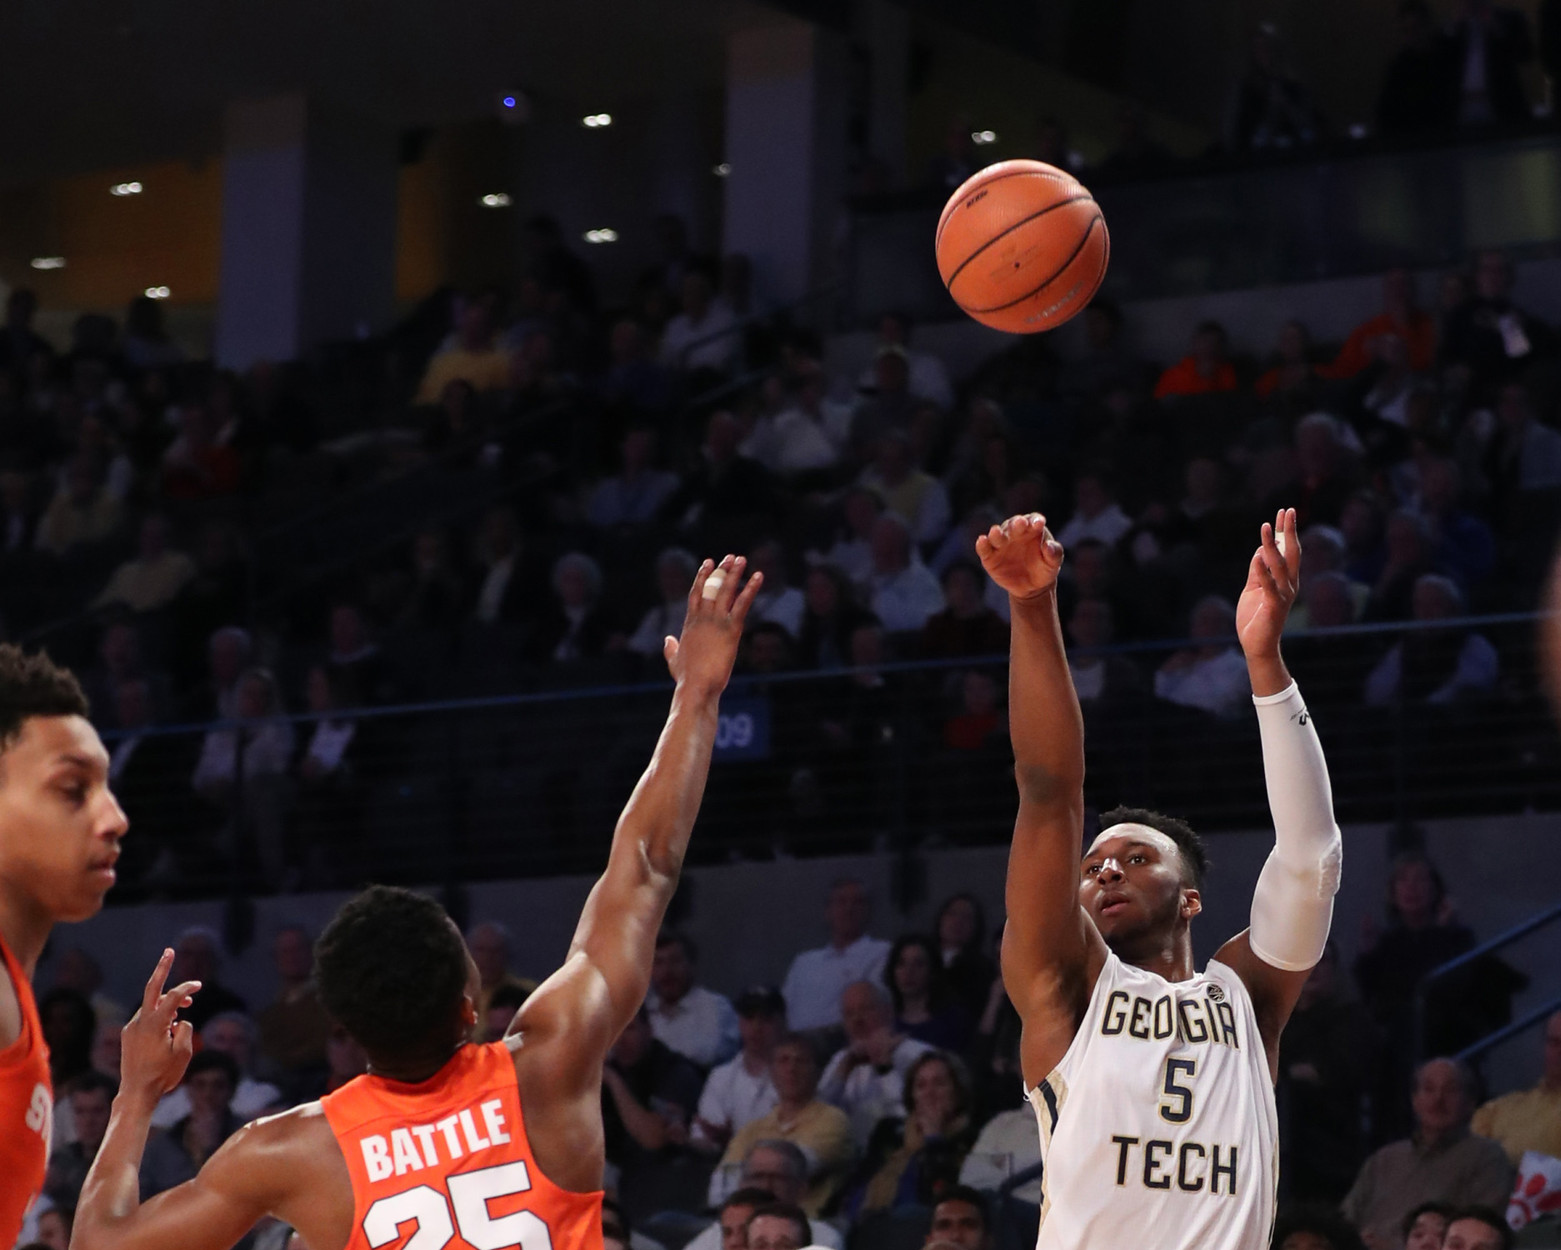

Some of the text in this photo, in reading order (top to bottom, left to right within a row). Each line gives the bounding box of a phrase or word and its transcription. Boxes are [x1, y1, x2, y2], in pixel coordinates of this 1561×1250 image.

[1101, 990, 1240, 1050] GEOGIA
[1159, 1056, 1198, 1125] 5
[360, 1098, 511, 1183] BATTLE
[1111, 1134, 1239, 1196] TECH
